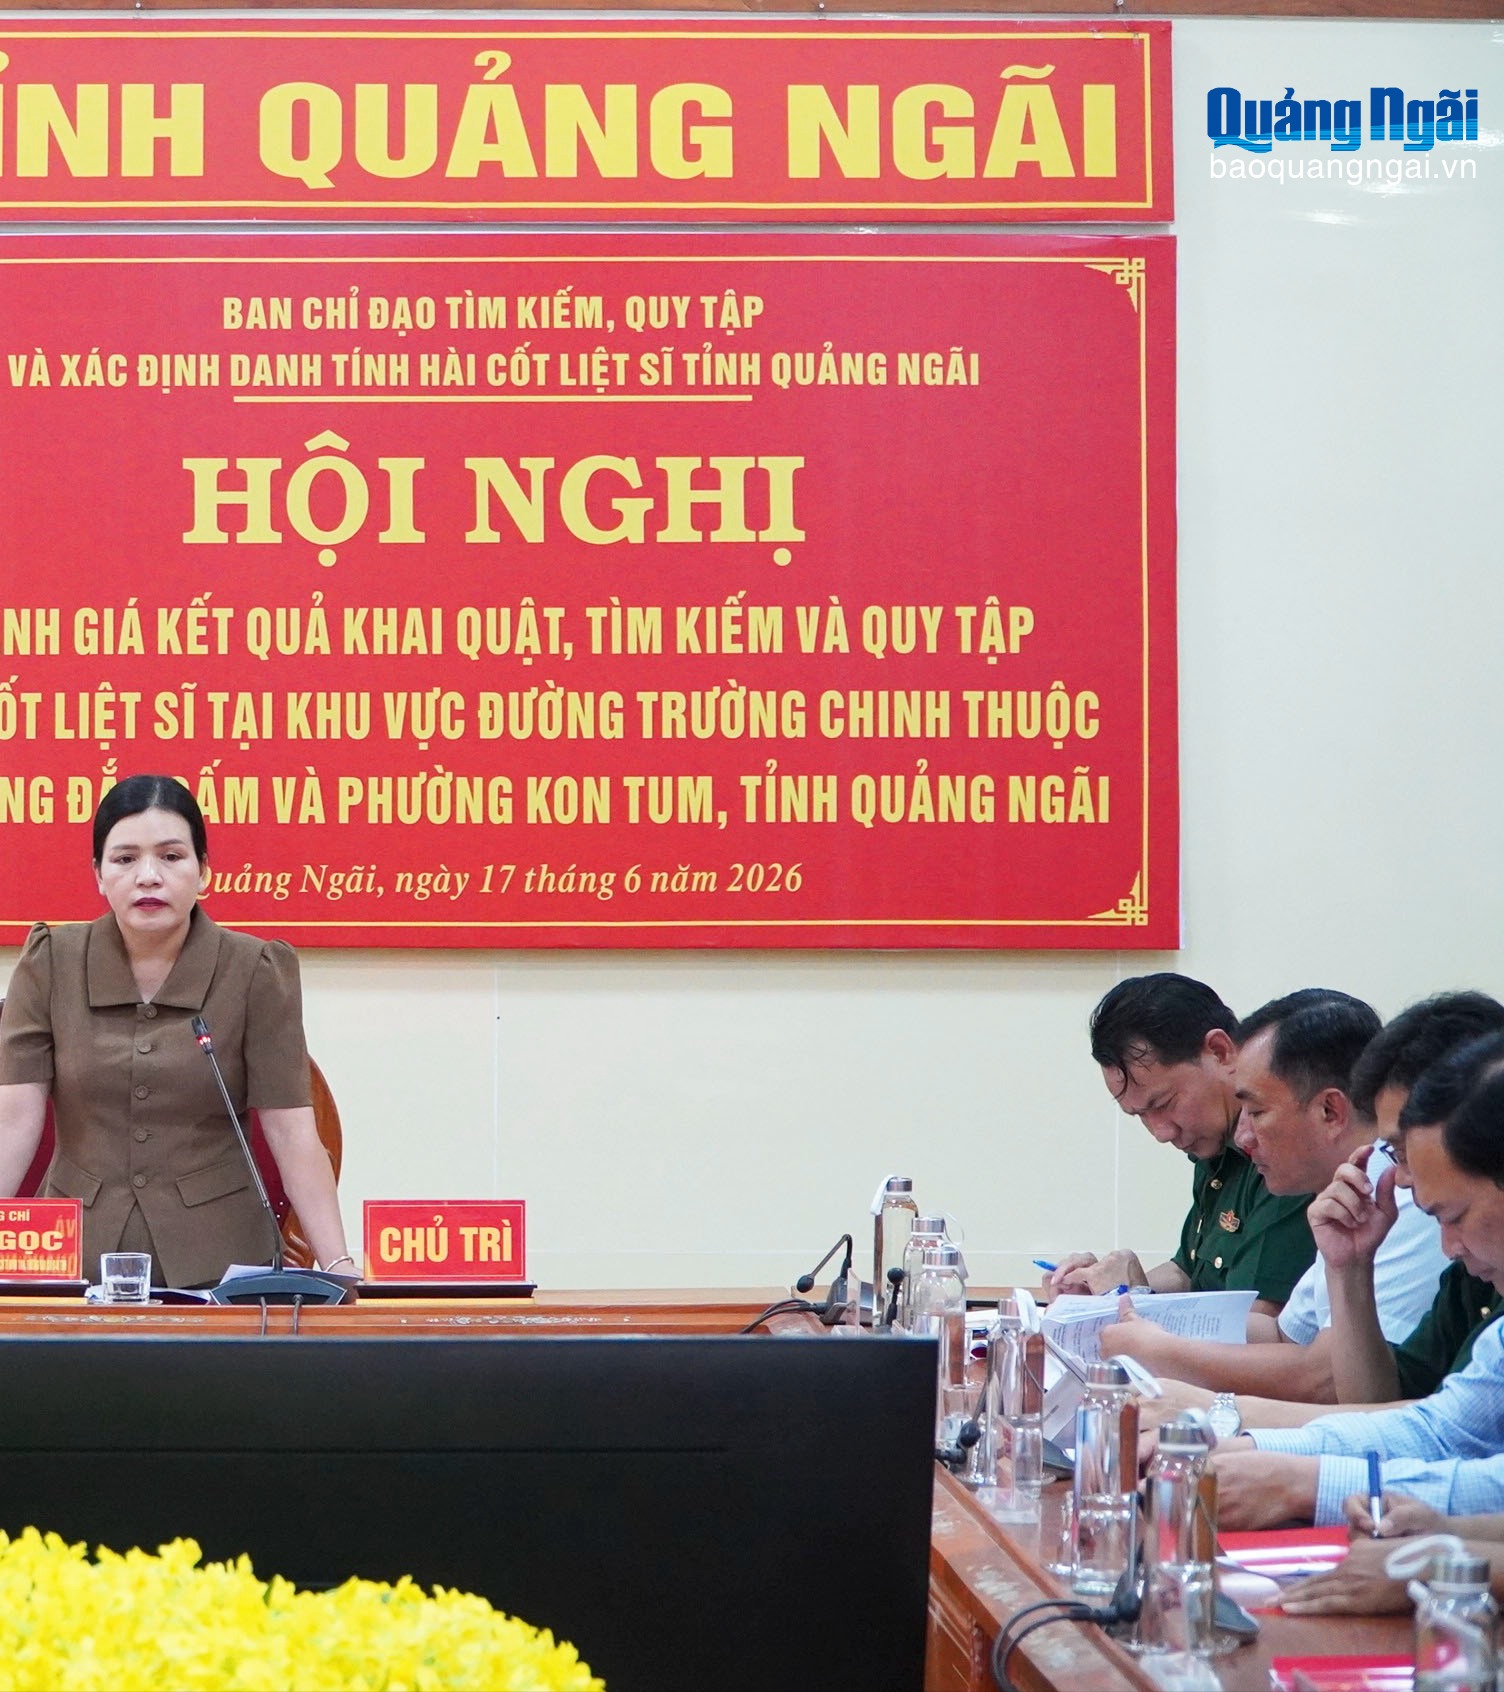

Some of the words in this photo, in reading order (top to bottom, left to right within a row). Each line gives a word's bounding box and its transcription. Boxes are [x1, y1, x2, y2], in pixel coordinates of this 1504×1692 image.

[258, 50, 734, 189] QUẢNG
[787, 64, 1117, 180] NGÃI
[223, 297, 292, 330] BAN
[302, 286, 360, 330] CHỈ
[368, 297, 436, 337] ĐẠO
[445, 290, 507, 330] TÌM
[517, 286, 615, 337] KIẾM,
[625, 296, 691, 332] QUY
[699, 289, 764, 337] TẬP
[8, 348, 51, 387] VÀ
[60, 347, 128, 388] XÁC
[137, 354, 220, 394] ĐỊNH
[229, 354, 322, 387] DANH
[331, 347, 410, 387] TÍNH
[420, 347, 476, 387] HÀI
[487, 342, 551, 387] CỐT
[560, 346, 630, 394] LIỆT
[639, 346, 675, 387] SĨ
[682, 341, 761, 386] TỈNH
[771, 341, 888, 390] QUẢNG
[897, 346, 980, 386] NGÃI
[183, 430, 425, 567] HỘI
[465, 455, 805, 567] NGHỊ
[74, 598, 145, 655] GIÁ
[158, 592, 234, 655] KẾT
[246, 591, 331, 660] QUẢ
[344, 607, 443, 655] KHAI
[456, 597, 573, 665] QUẬT,
[586, 597, 663, 655] TÌM
[677, 590, 783, 654] KIẾM
[795, 596, 850, 654] VÀ
[862, 606, 944, 660] QUY
[955, 596, 1035, 664] TẬP
[55, 682, 142, 751] LIỆT
[154, 682, 198, 740] SĨ
[208, 692, 273, 751] TẠI
[287, 692, 371, 740] KHU
[384, 687, 465, 751] VỰC
[478, 680, 624, 740] ĐƯỜNG
[637, 679, 806, 740] TRƯỜNG
[819, 690, 950, 739] CHINH
[963, 681, 1100, 750] THUỘC
[172, 759, 259, 824] ẤM
[272, 765, 326, 824] VÀ
[338, 764, 513, 825] PHƯỜNG
[526, 776, 611, 825] KON
[623, 776, 728, 830] TUM,
[740, 759, 838, 823] TỈNH
[851, 759, 995, 829] QUẢNG
[1009, 766, 1110, 824] NGÃI
[299, 865, 385, 901] Ngãi,
[395, 864, 470, 901] ngày
[479, 864, 517, 893] 17
[524, 863, 617, 901] tháng
[625, 864, 641, 893] 6
[650, 863, 718, 893] năm
[726, 863, 802, 893] 2026
[8, 1209, 30, 1221] CHÍ
[379, 1215, 449, 1263] CHỦ
[459, 1219, 513, 1262] TRÌ
